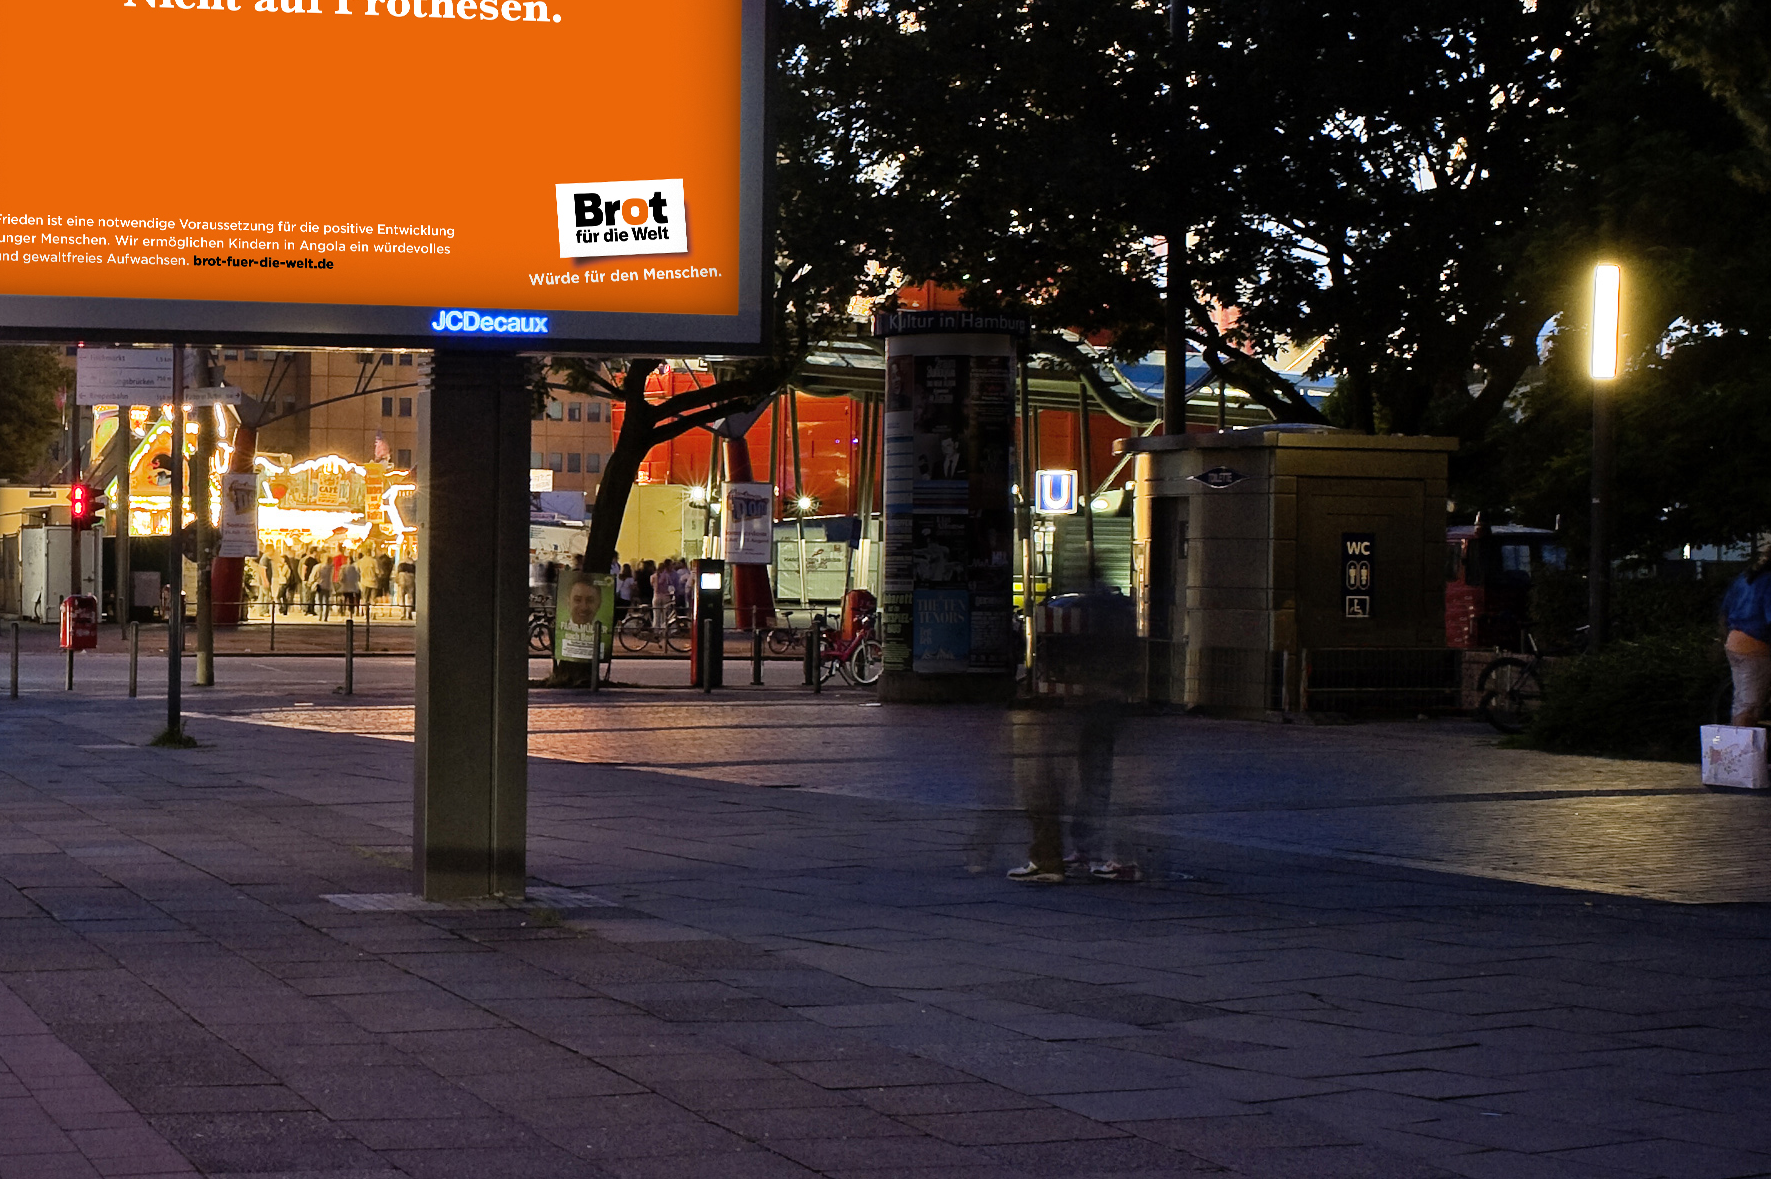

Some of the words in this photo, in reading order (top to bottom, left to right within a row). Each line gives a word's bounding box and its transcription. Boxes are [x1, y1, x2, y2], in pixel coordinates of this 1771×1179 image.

[574, 192, 668, 227] Brot
[47, 214, 63, 227] ist
[67, 216, 94, 227] eine
[98, 217, 175, 231] notwendige
[179, 218, 274, 234] Voraussetzung
[277, 221, 297, 233] für
[300, 222, 320, 233] die
[323, 222, 374, 236] positive
[377, 224, 455, 239] Entwicklung
[576, 229, 599, 243] für
[603, 227, 629, 242] die
[632, 226, 669, 241] Welt
[41, 233, 110, 246] Menschen.
[115, 235, 139, 246] Wir
[142, 236, 224, 250] ermöglichen
[228, 238, 280, 250] Kindern
[284, 240, 295, 251] in
[299, 240, 346, 254] Angola
[349, 241, 369, 252] ein
[373, 242, 451, 255] würdevolles
[22, 251, 103, 264] gewaltfreies
[106, 253, 190, 266] Aufwachsen.
[193, 254, 335, 270] brot-fuer-die-welt.de
[529, 270, 580, 286] Würde
[584, 270, 606, 284] für
[610, 269, 639, 282] den
[643, 266, 723, 281] Menschen.
[431, 310, 549, 334] JCDecaux
[889, 314, 934, 330] Kultur
[939, 312, 955, 328] in
[961, 313, 1026, 331] Hamburg
[1041, 474, 1071, 510] U
[1346, 540, 1372, 556] WC
